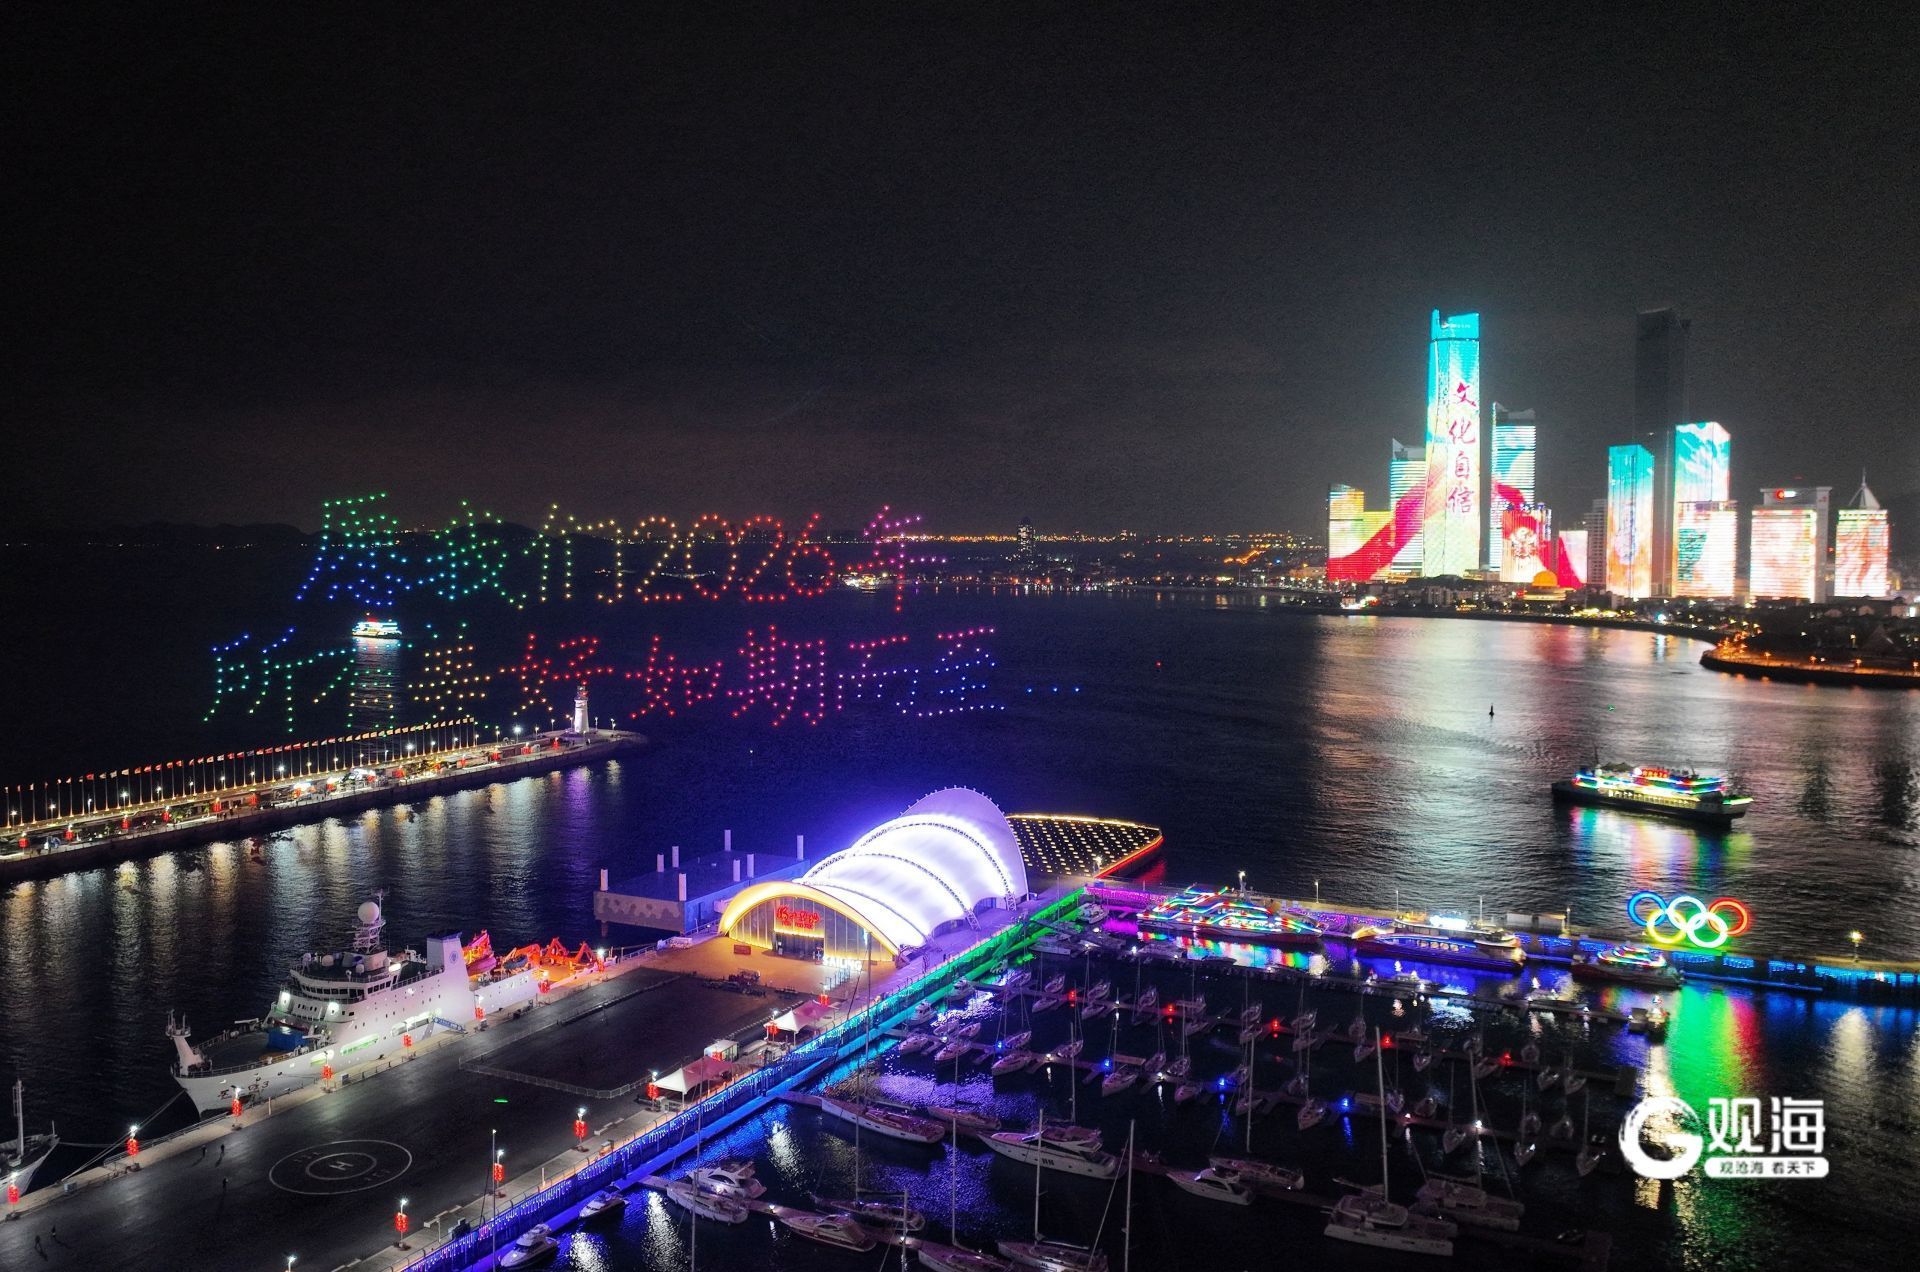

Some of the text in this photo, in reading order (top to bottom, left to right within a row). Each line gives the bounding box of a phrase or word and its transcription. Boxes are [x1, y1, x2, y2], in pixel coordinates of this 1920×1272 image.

[1448, 381, 1477, 514] 文化自信
[329, 1160, 354, 1171] H
